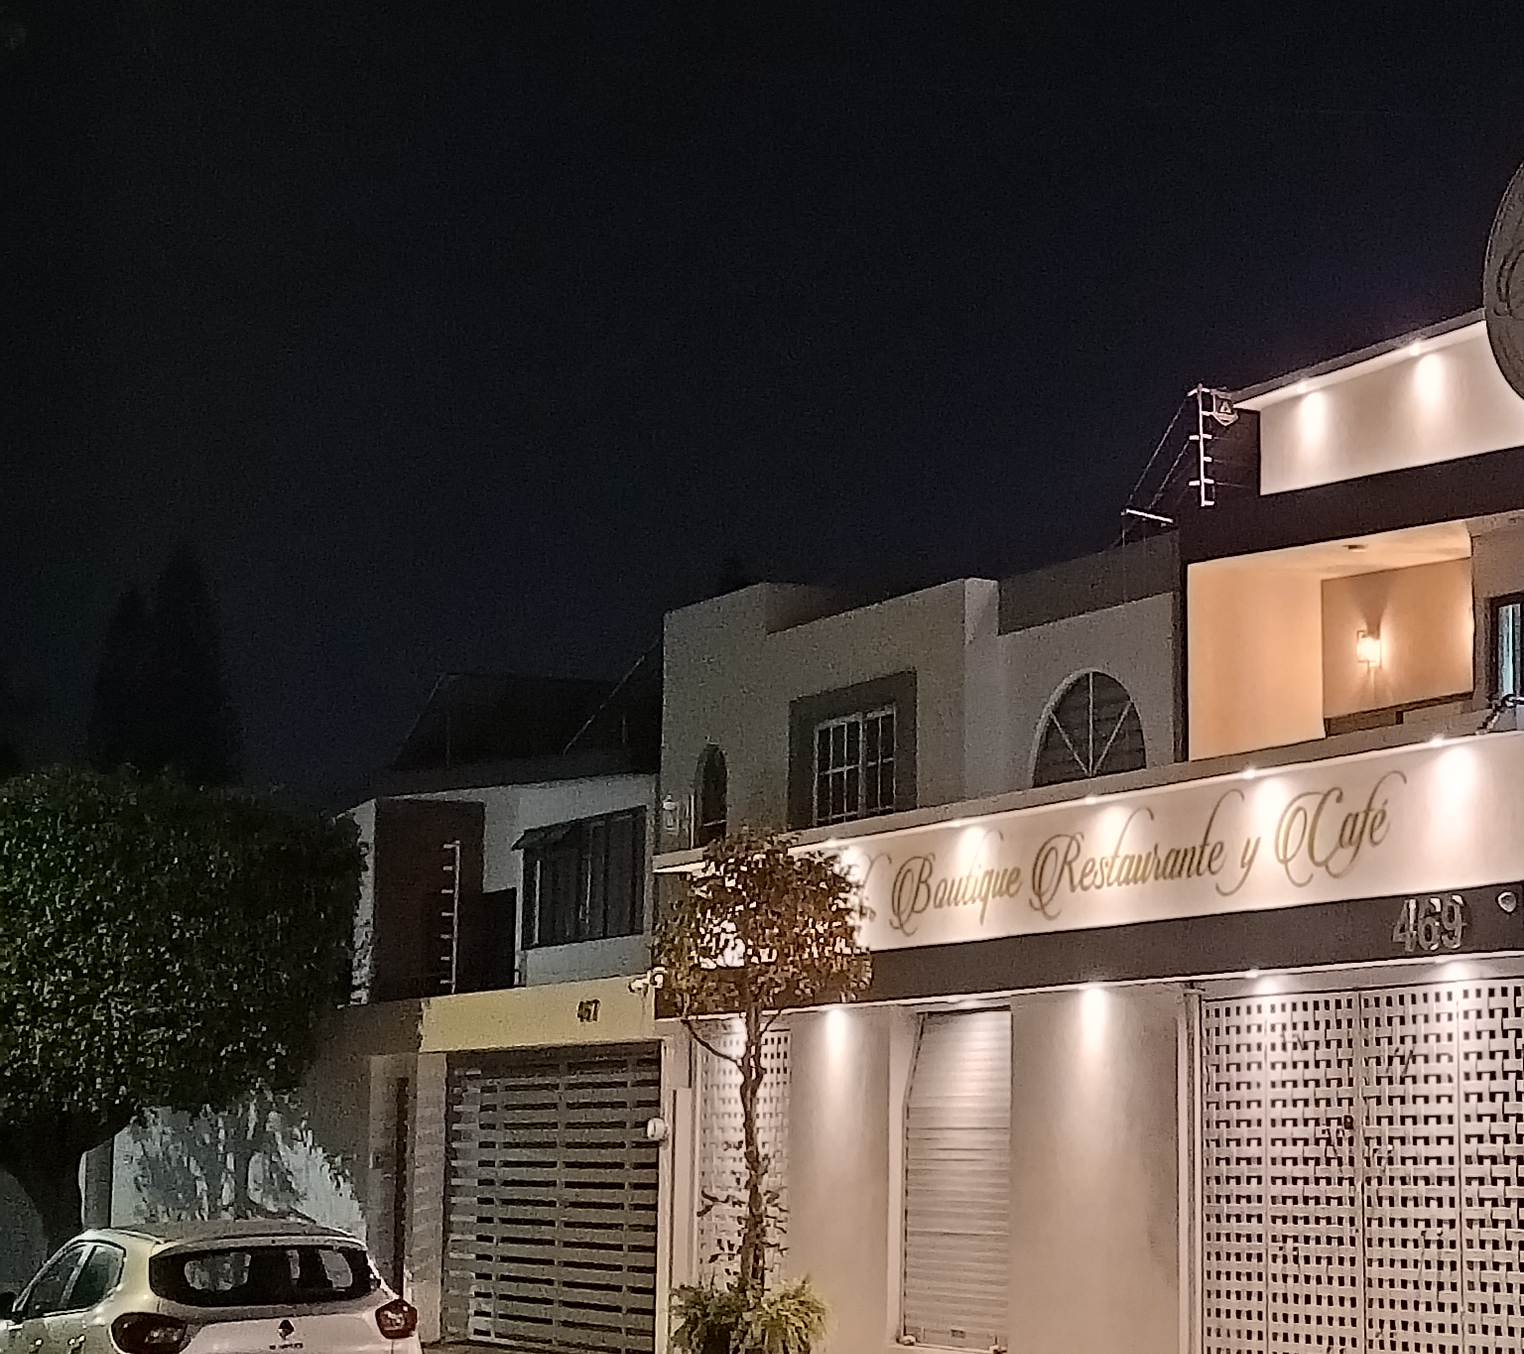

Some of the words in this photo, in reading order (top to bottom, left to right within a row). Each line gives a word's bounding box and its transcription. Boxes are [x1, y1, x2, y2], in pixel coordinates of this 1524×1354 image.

[889, 828, 1024, 936] Boutique
[1029, 789, 1245, 921] Restaurante
[1215, 836, 1261, 896] y
[1274, 771, 1408, 887] Café
[1393, 895, 1463, 952] 469
